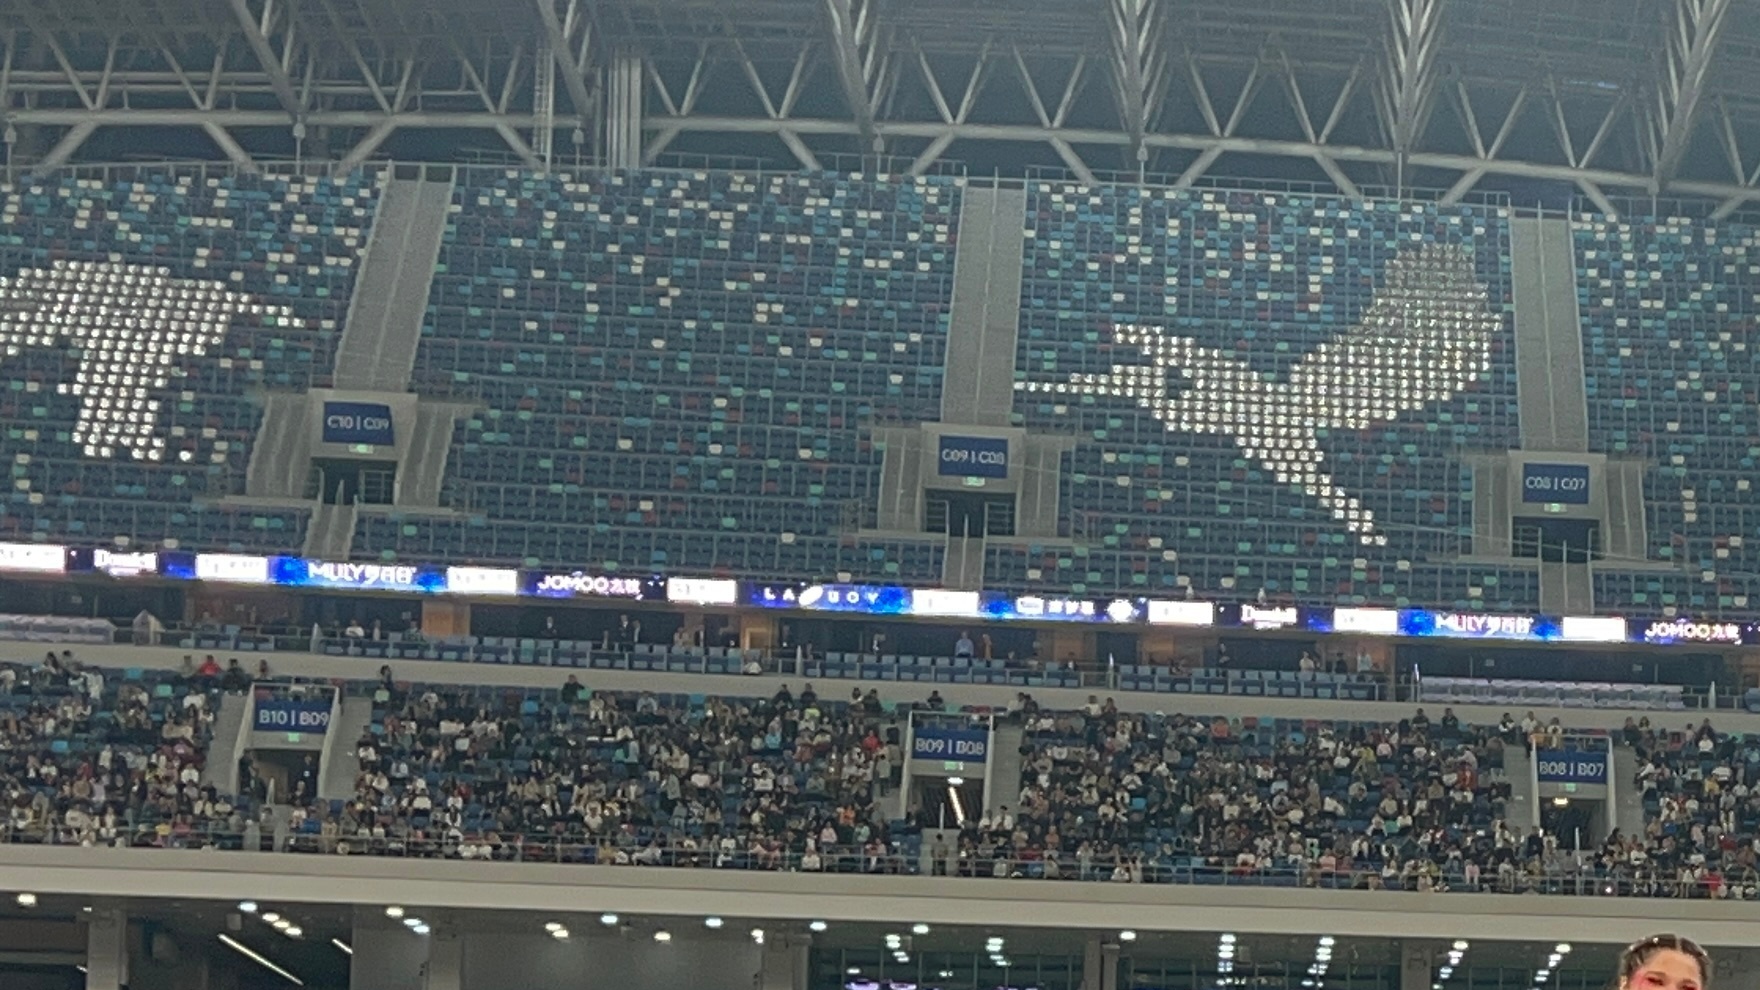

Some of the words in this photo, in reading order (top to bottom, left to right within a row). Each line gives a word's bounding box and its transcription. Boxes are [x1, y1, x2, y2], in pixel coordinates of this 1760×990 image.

[259, 710, 288, 725] B10
[300, 711, 330, 726] B09
[915, 738, 944, 752] B09
[956, 740, 985, 756] B08
[1539, 761, 1568, 775] B08
[1577, 762, 1606, 777] B07
